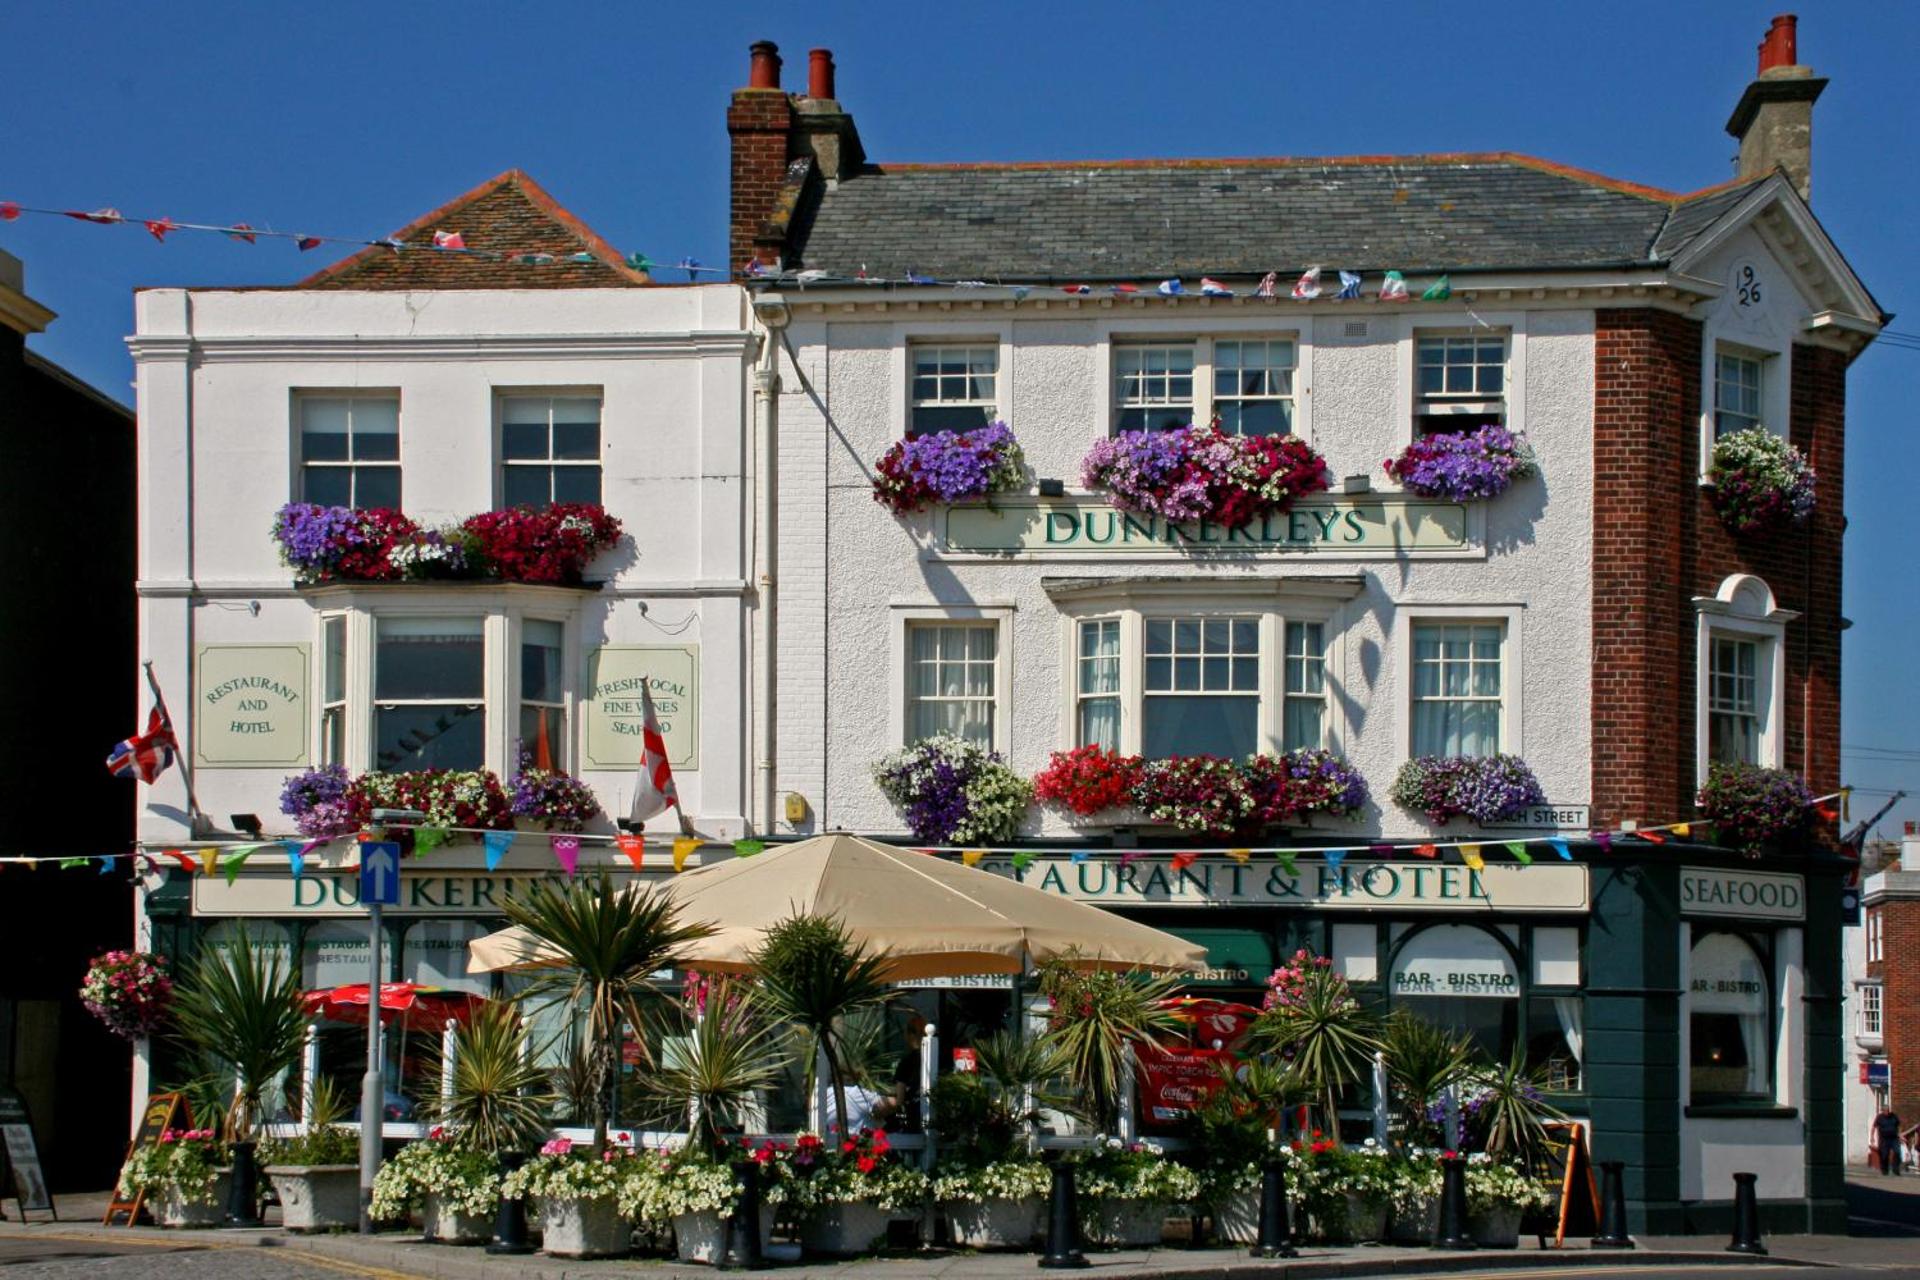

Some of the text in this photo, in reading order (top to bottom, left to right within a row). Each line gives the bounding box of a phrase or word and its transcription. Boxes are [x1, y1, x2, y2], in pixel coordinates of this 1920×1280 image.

[1045, 509, 1368, 544] DUNKERLEYS
[206, 677, 299, 704] RESTAURANT
[595, 678, 686, 697] FRESH OCAL
[238, 699, 268, 711] AND
[603, 701, 678, 713] FINE NES
[230, 721, 275, 734] HOTEL
[611, 721, 672, 736] SEAFD
[1533, 810, 1584, 824] STREET
[1265, 864, 1303, 898] &
[1317, 863, 1492, 900] HOTEL
[293, 875, 601, 907] DUKERLYS
[1682, 876, 1799, 909] SEAFOOD
[307, 939, 391, 951] STAURAT
[406, 939, 470, 951] RESTAUR
[1151, 969, 1181, 981] BR
[1194, 968, 1249, 981] BISTRO
[1395, 971, 1431, 985] BAR
[1447, 972, 1515, 987] BISTRO
[1718, 980, 1761, 994] BISTRO
